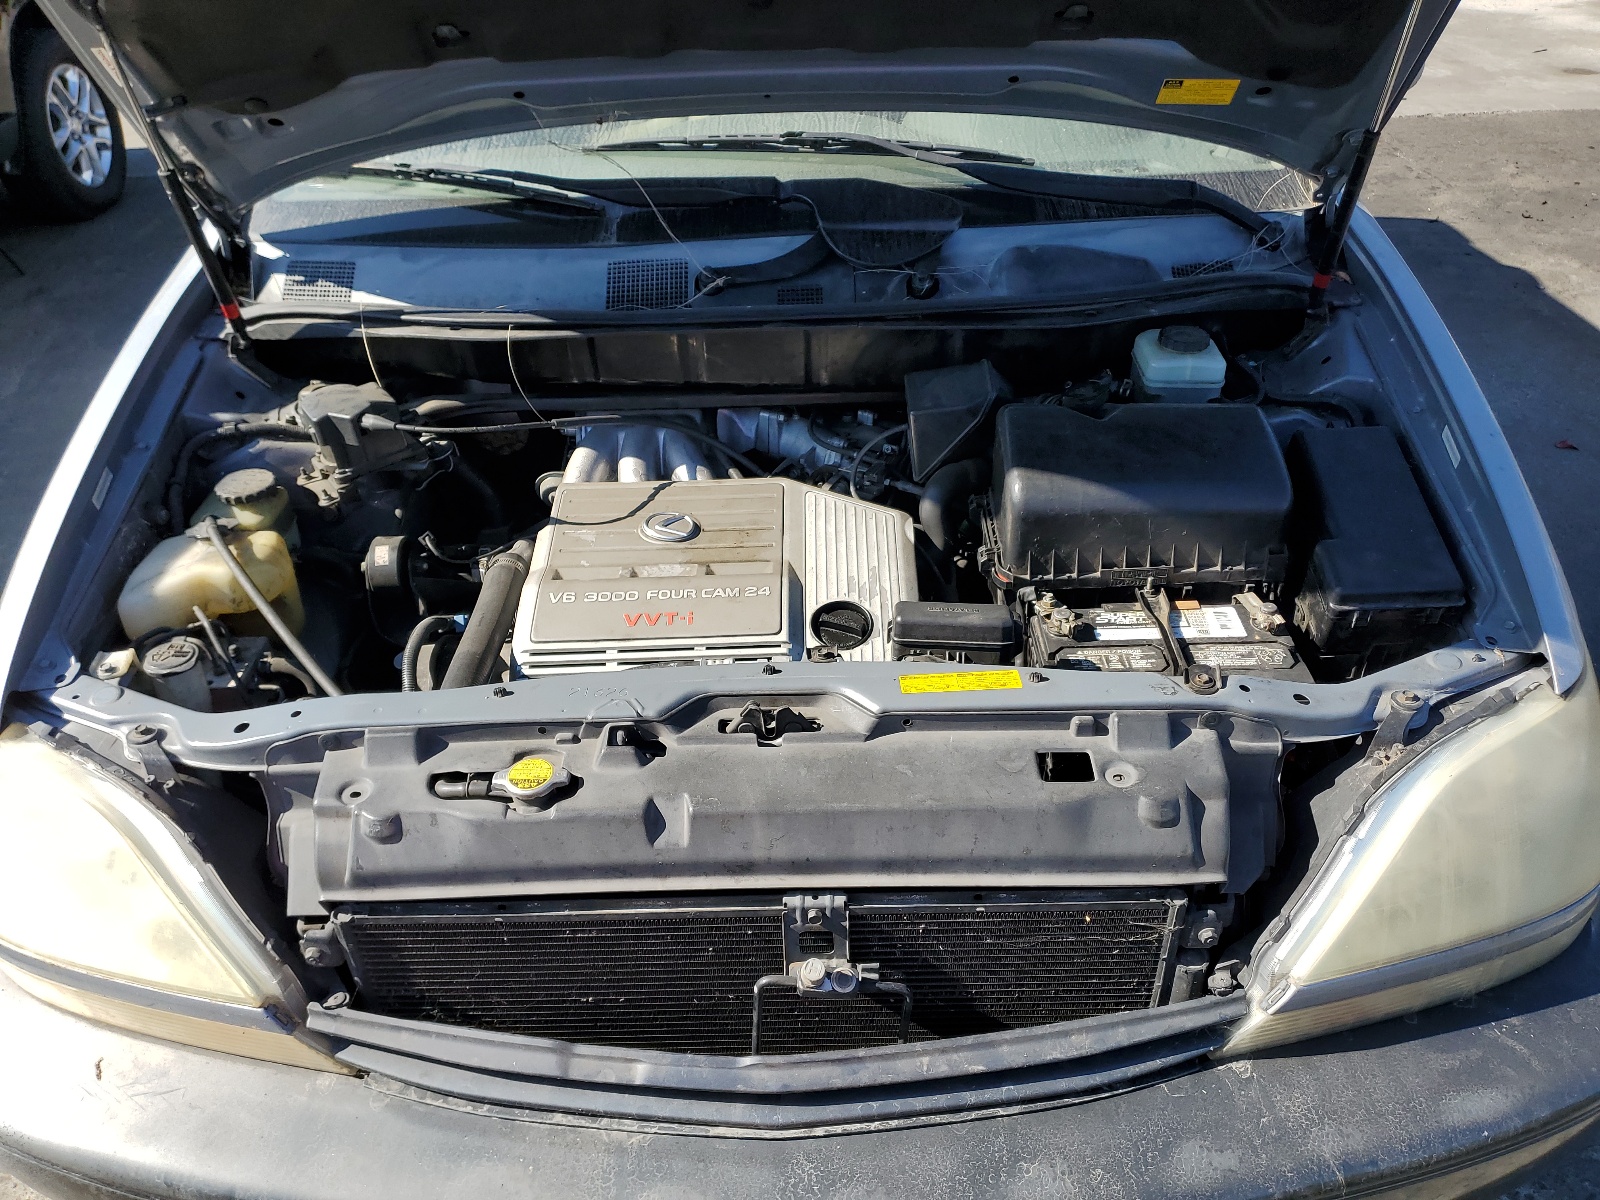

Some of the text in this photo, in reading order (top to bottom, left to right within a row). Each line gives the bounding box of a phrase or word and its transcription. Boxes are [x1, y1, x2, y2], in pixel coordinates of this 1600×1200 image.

[549, 586, 771, 604] V6 3000 FOUR CAM 24
[623, 610, 694, 627] VVT-i
